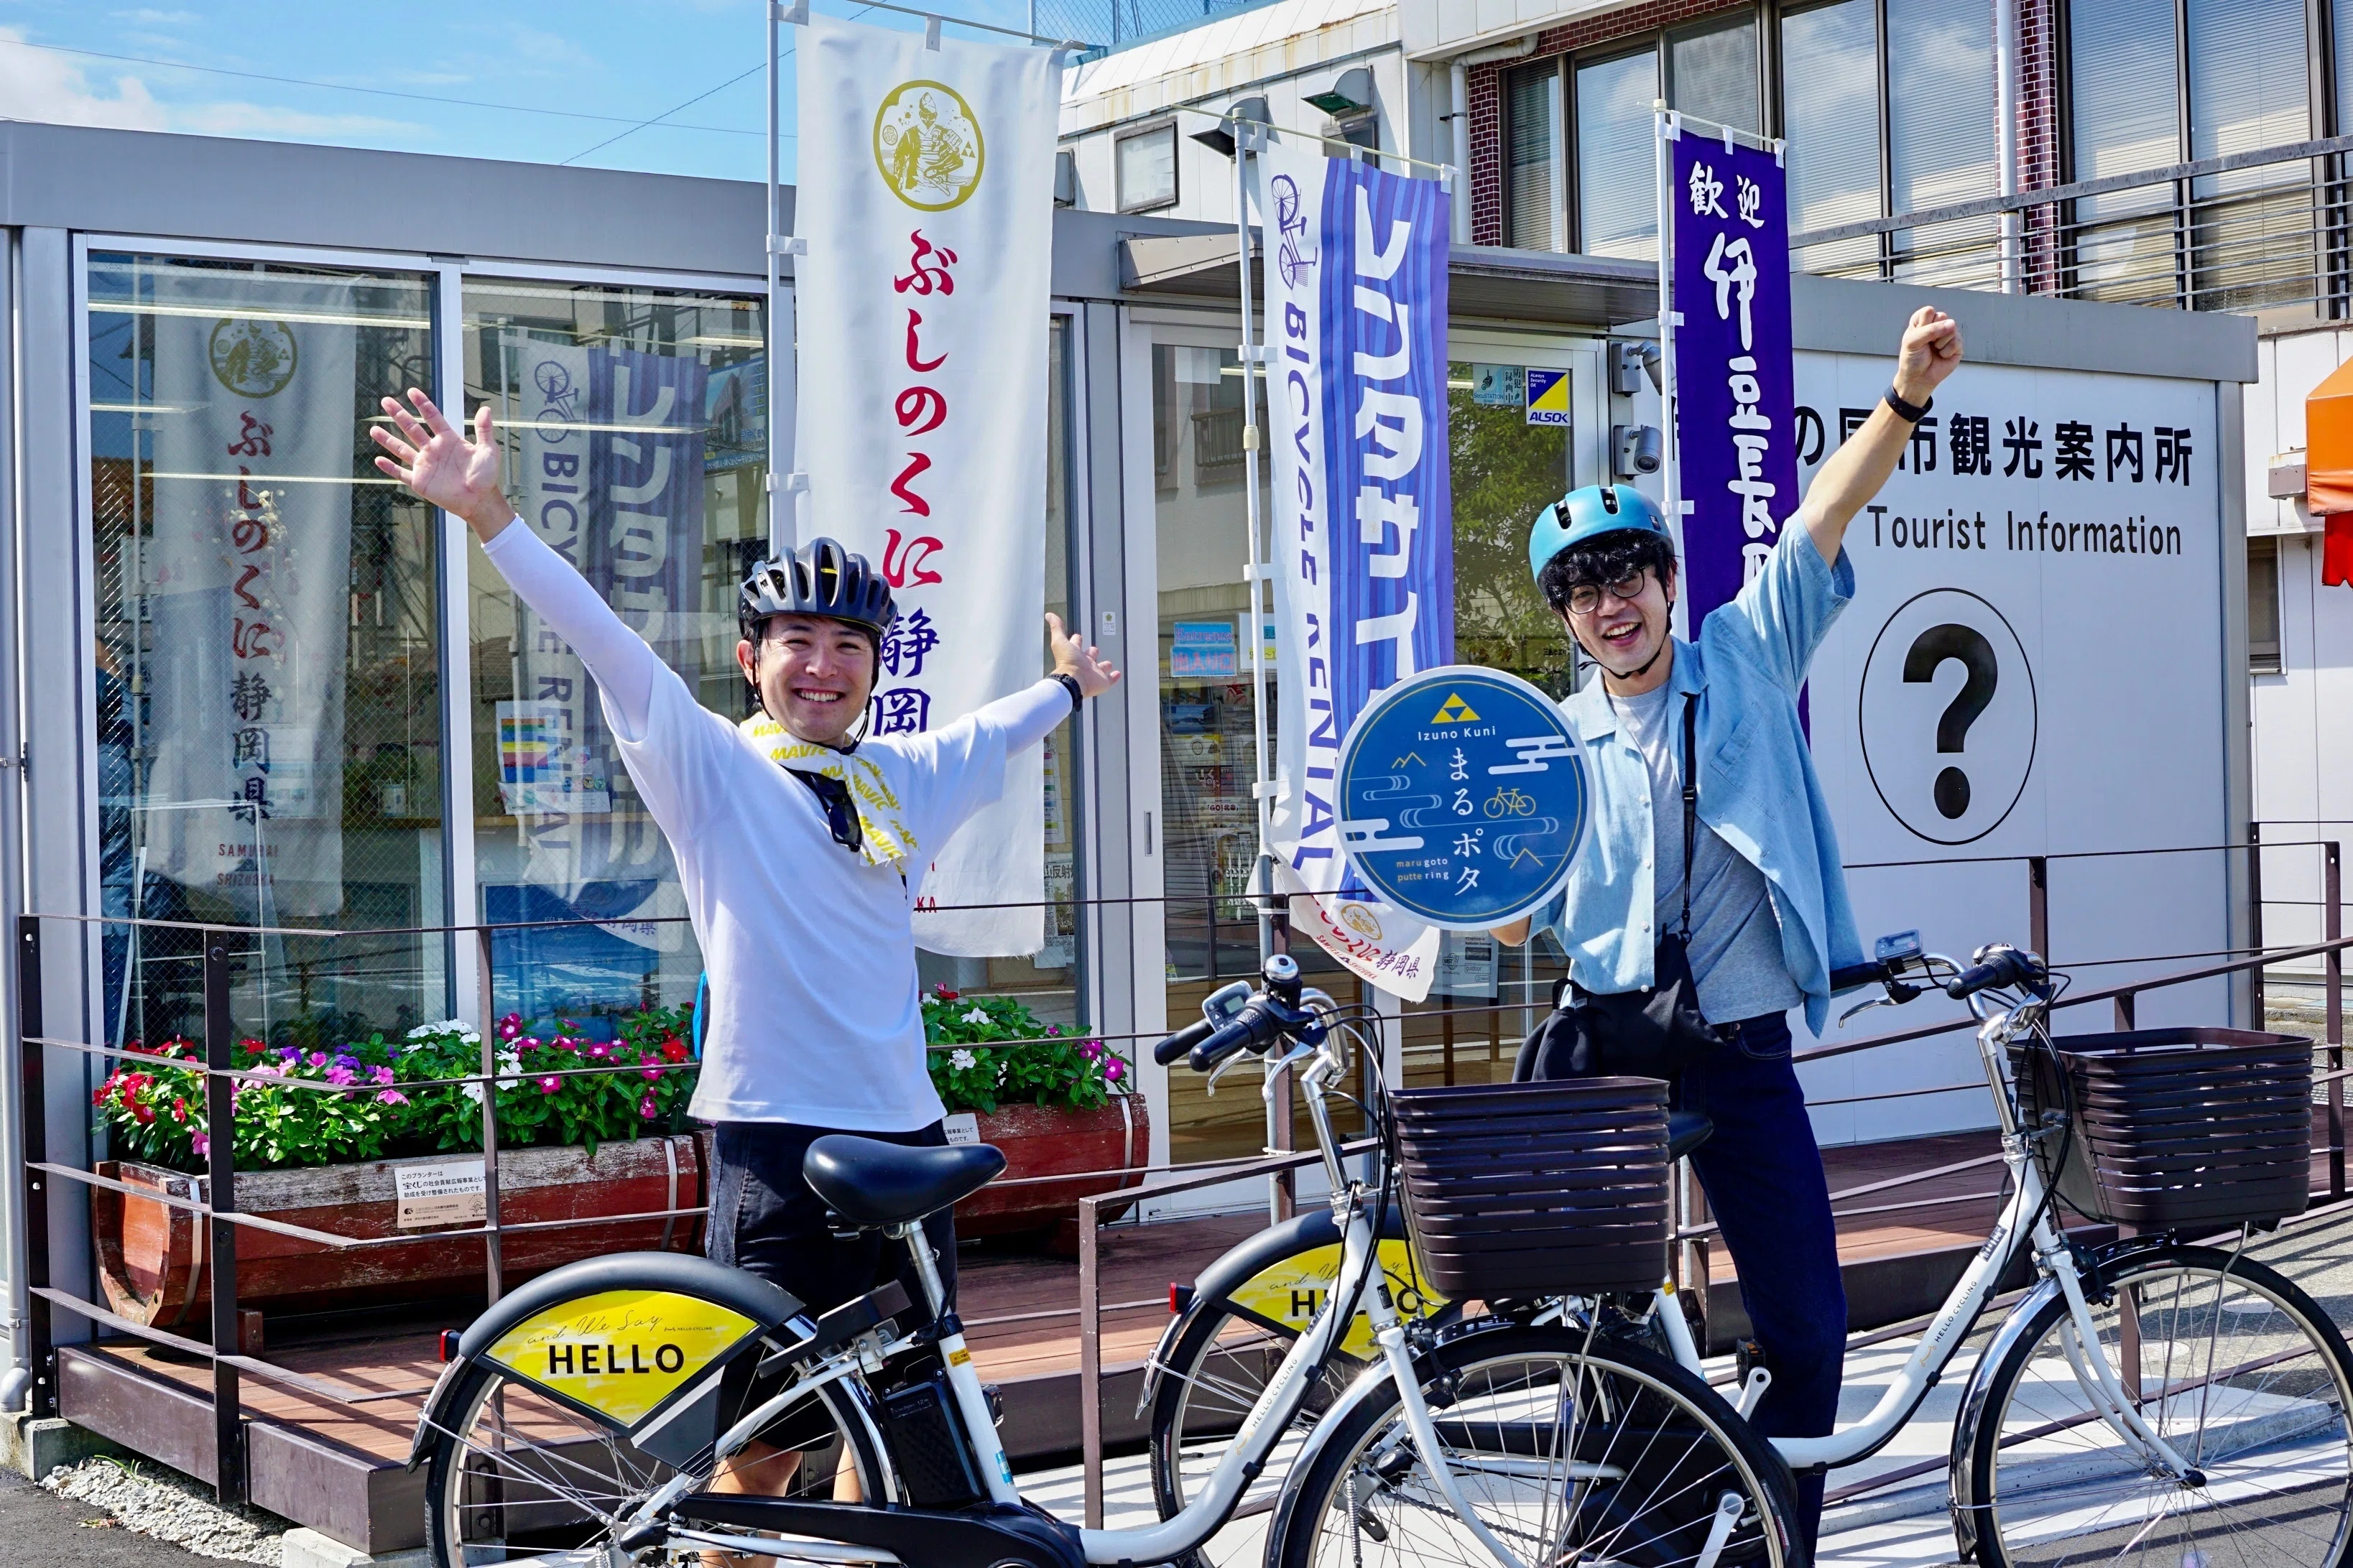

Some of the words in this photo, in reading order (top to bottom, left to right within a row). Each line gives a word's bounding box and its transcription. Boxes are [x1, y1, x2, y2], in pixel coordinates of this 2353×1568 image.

[1688, 160, 1765, 228] 歓迎
[1529, 412, 1568, 423] ALSOK
[1867, 504, 1986, 551] Tourist
[2007, 509, 2181, 555] Information
[1173, 652, 1234, 672] 出入り口
[1418, 729, 1457, 741] Izuno
[1464, 725, 1496, 738] Kuni
[1449, 747, 1484, 896] まるポタ
[401, 1171, 443, 1180] このプランターは
[527, 1325, 568, 1345] and
[576, 1316, 611, 1337] We
[617, 1309, 663, 1332] Say
[1934, 1315, 1954, 1342] HELLO
[1953, 1280, 1977, 1314] CYCLING
[549, 1343, 684, 1374] HELLO
[1252, 1397, 1273, 1427] HELLO
[1272, 1358, 1298, 1396] CYCLING
